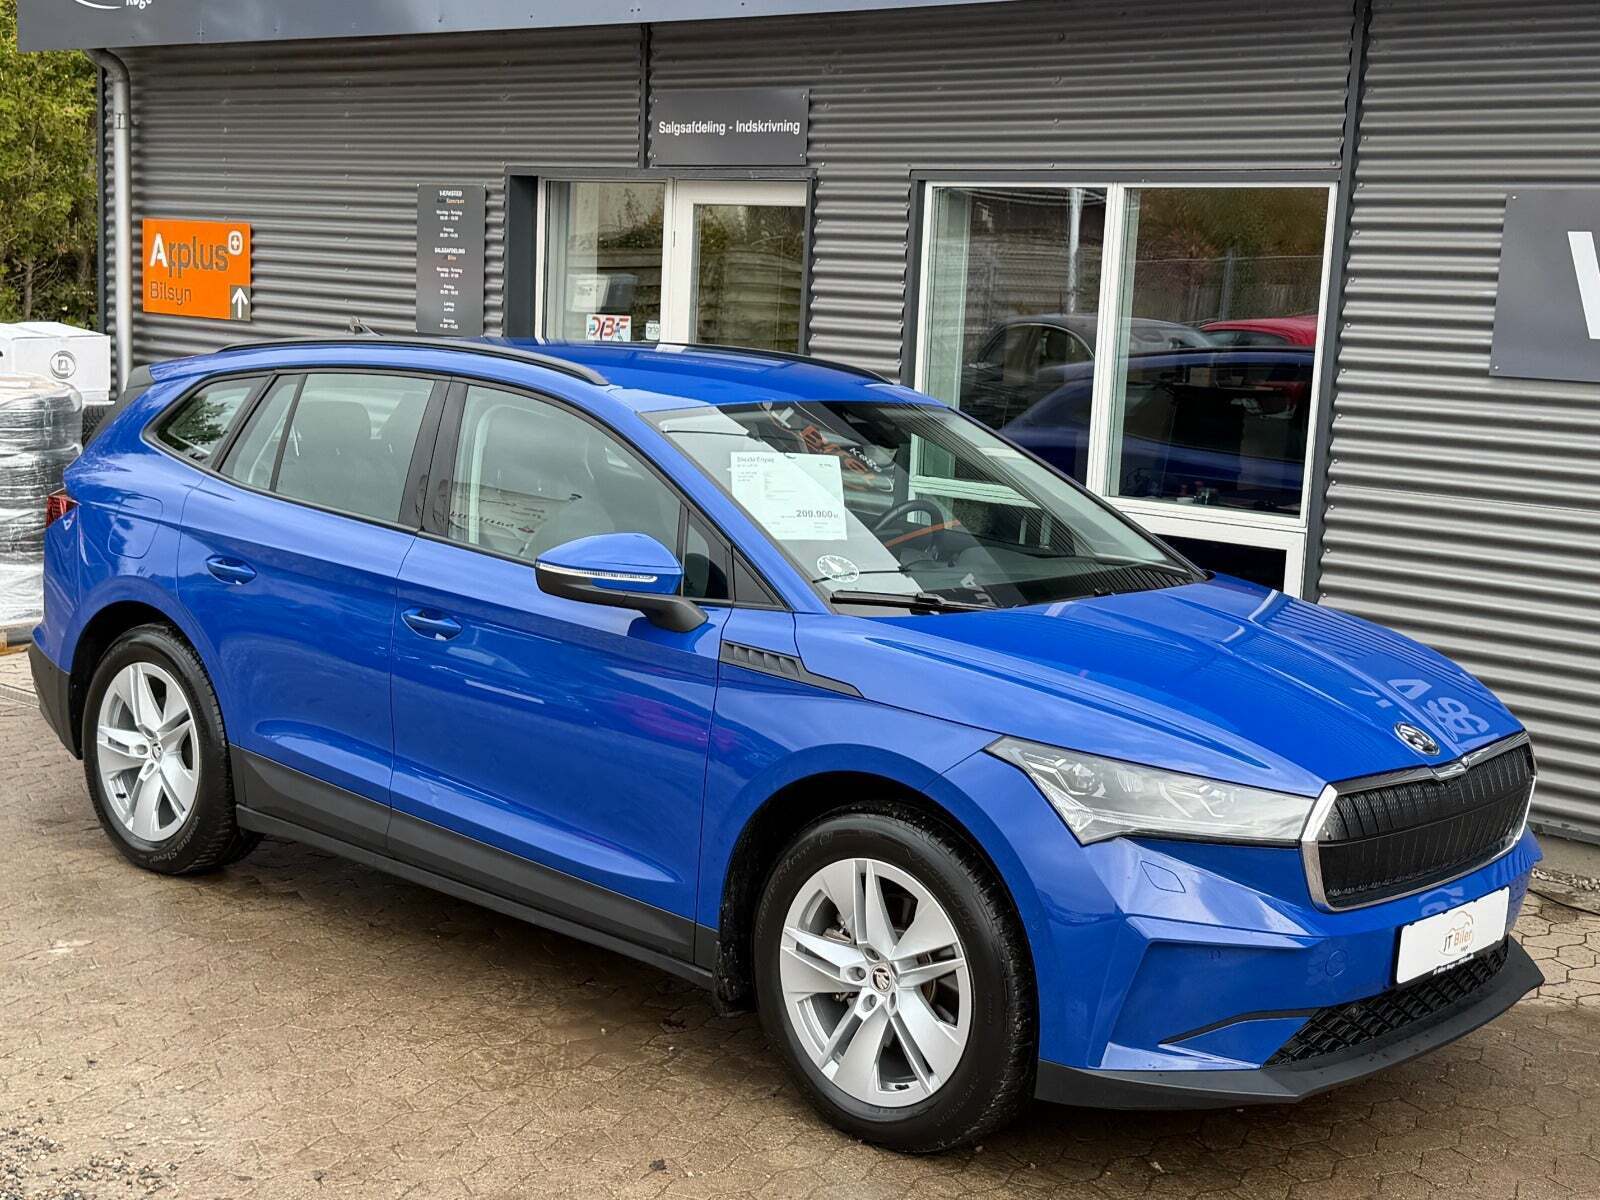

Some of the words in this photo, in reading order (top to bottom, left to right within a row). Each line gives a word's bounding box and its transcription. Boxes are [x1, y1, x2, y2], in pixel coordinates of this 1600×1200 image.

[658, 120, 725, 136] Salgsafdeling
[736, 119, 801, 135] Indskrivning
[150, 281, 192, 305] Bilsyn
[1454, 930, 1472, 946] Biler
